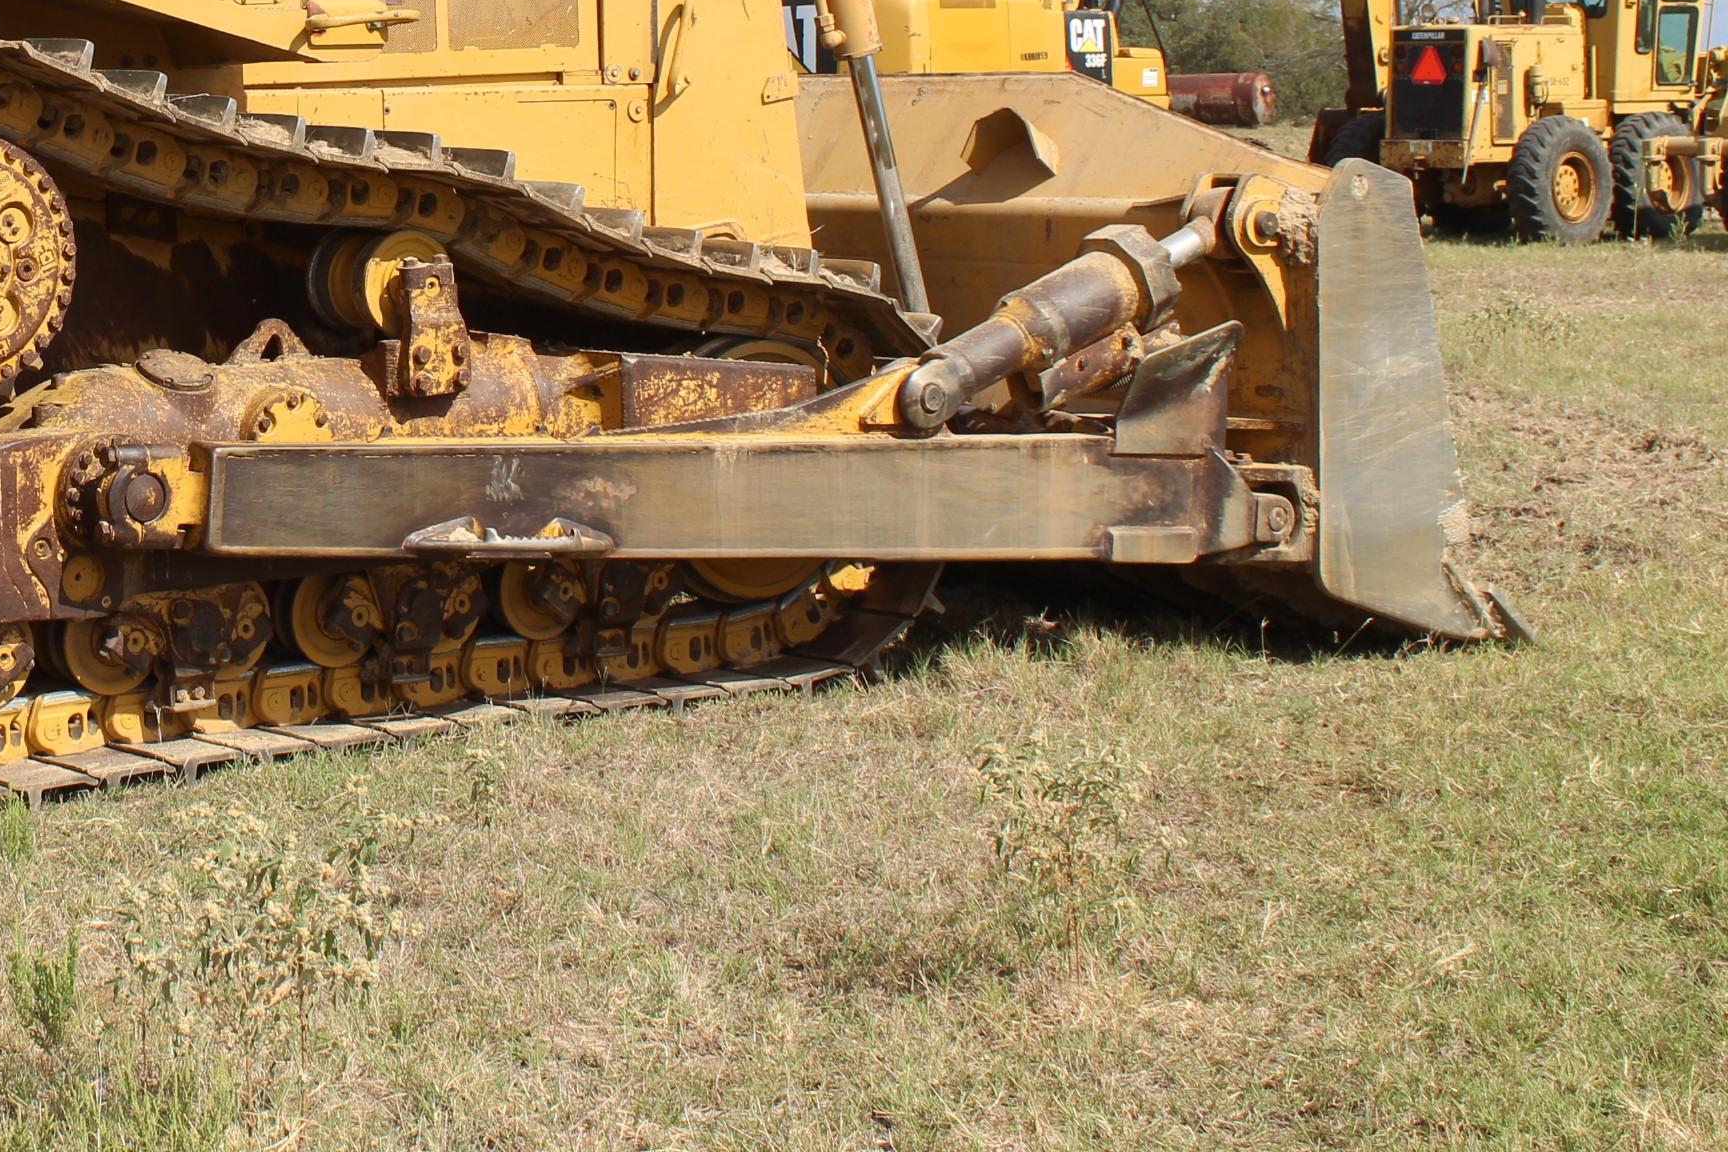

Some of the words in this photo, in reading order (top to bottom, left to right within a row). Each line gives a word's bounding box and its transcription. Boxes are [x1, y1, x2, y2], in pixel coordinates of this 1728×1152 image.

[1069, 18, 1106, 53] CAT
[1411, 31, 1445, 40] CATERPILLAR
[1084, 53, 1108, 68] 336F
